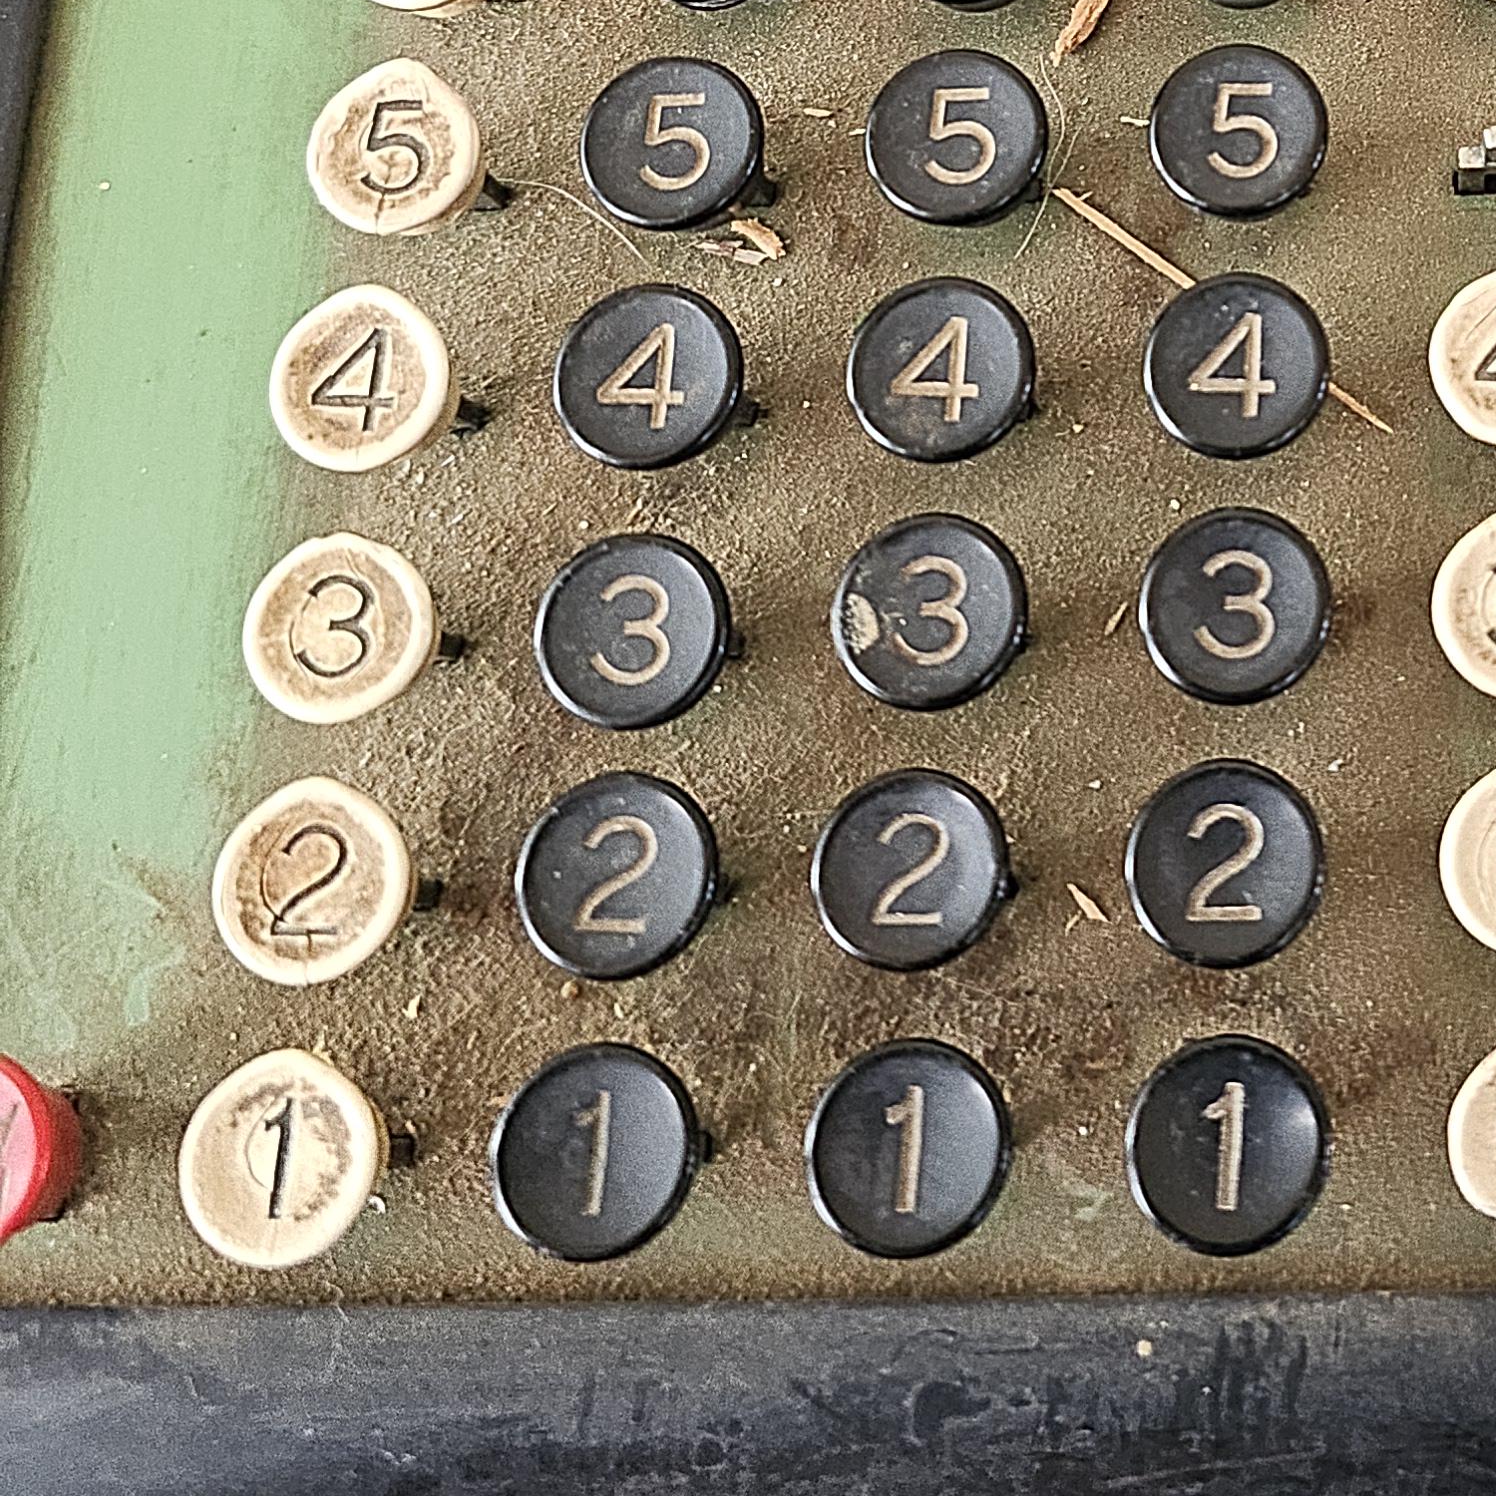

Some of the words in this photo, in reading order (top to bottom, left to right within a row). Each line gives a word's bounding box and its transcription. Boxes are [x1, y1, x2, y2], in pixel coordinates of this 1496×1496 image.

[360, 99, 432, 195] 5
[640, 93, 711, 191] 5
[925, 86, 996, 185] 5
[1207, 83, 1278, 179] 5
[312, 327, 394, 431] 4
[597, 323, 685, 430] 4
[890, 316, 980, 422] 4
[1189, 312, 1276, 418] 4
[297, 574, 375, 677] 3
[591, 574, 670, 687] 3
[894, 554, 969, 666] 3
[1194, 549, 1276, 659] 3
[271, 824, 348, 936] 2
[574, 814, 658, 934] 2
[872, 813, 949, 925] 2
[1186, 803, 1264, 922] 2
[265, 1097, 293, 1219] 1
[572, 1089, 611, 1216] 1
[885, 1085, 924, 1214] 1
[1201, 1081, 1245, 1210] 1
